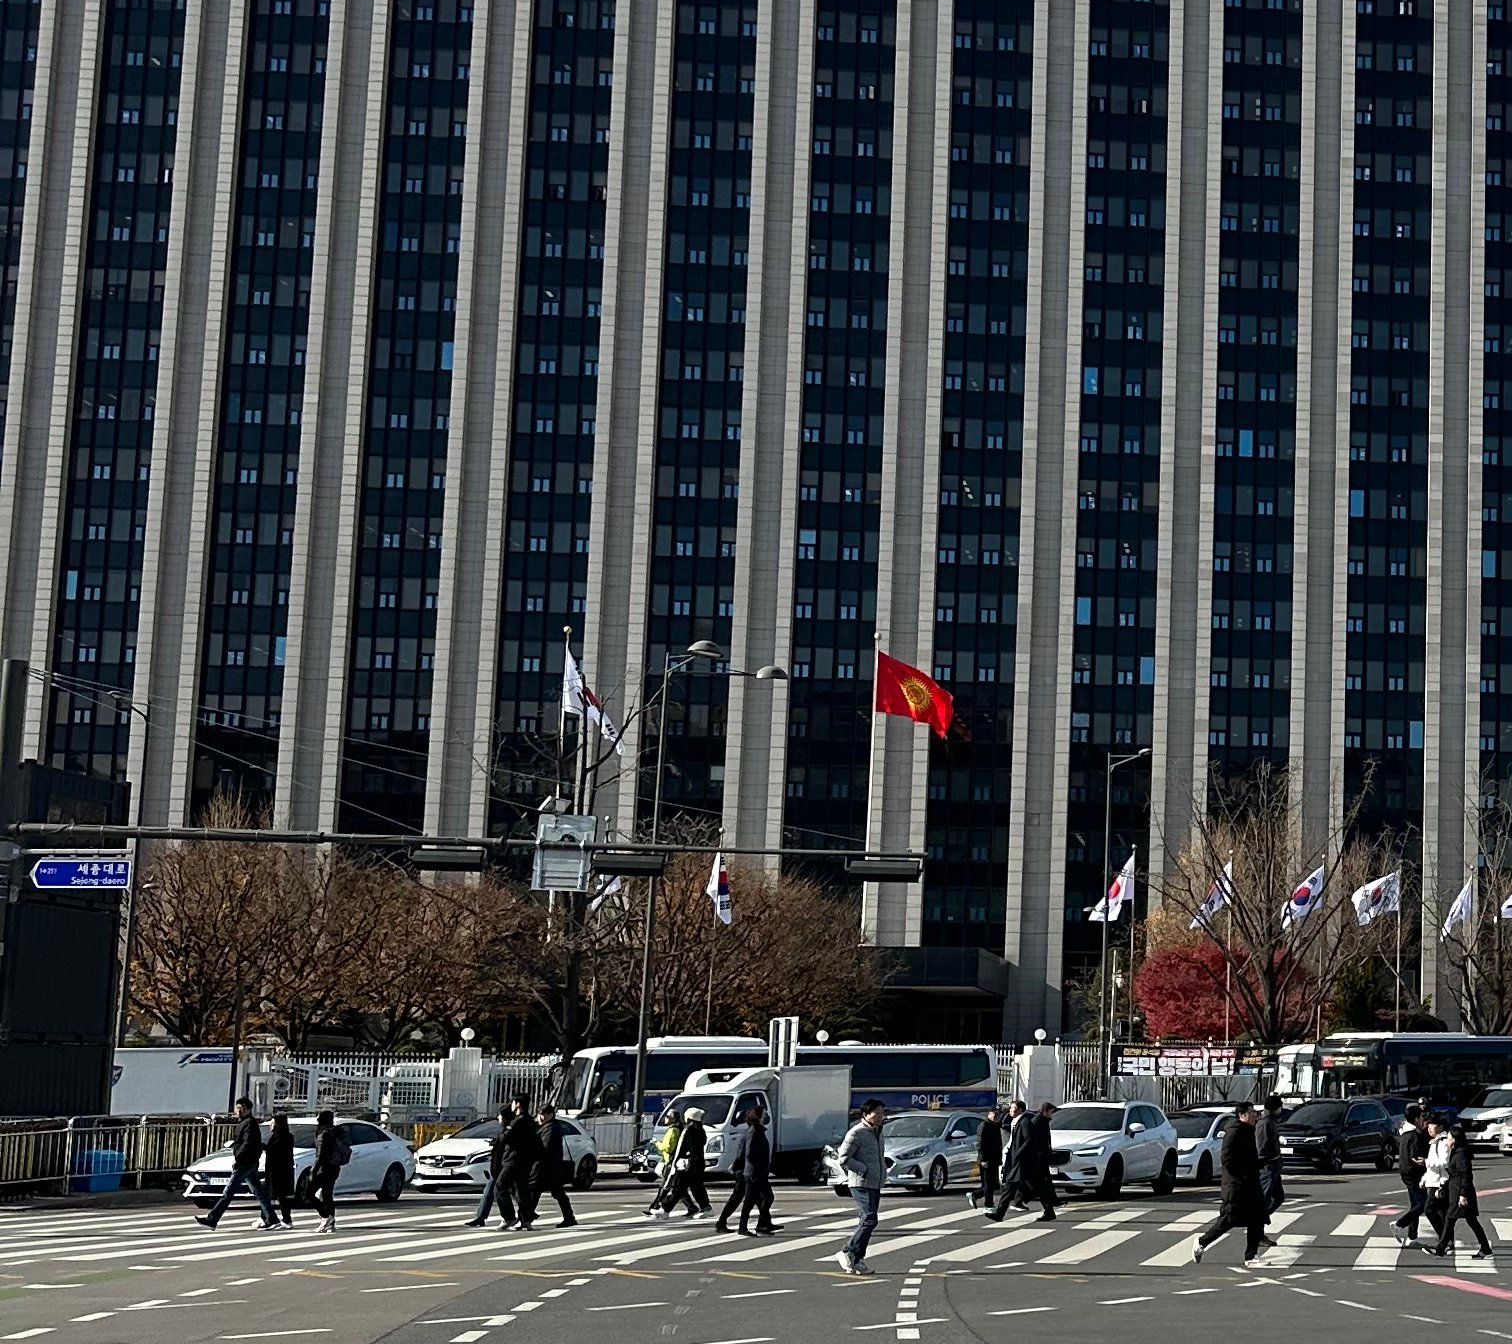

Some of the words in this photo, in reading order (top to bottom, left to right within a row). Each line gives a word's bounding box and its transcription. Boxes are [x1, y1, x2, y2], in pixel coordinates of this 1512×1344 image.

[77, 862, 127, 875] 세종대로
[70, 876, 126, 886] Sejong-daero
[1122, 1057, 1156, 1076] 국민
[1158, 1056, 1209, 1076] 행동의
[911, 1094, 951, 1105] POLICE
